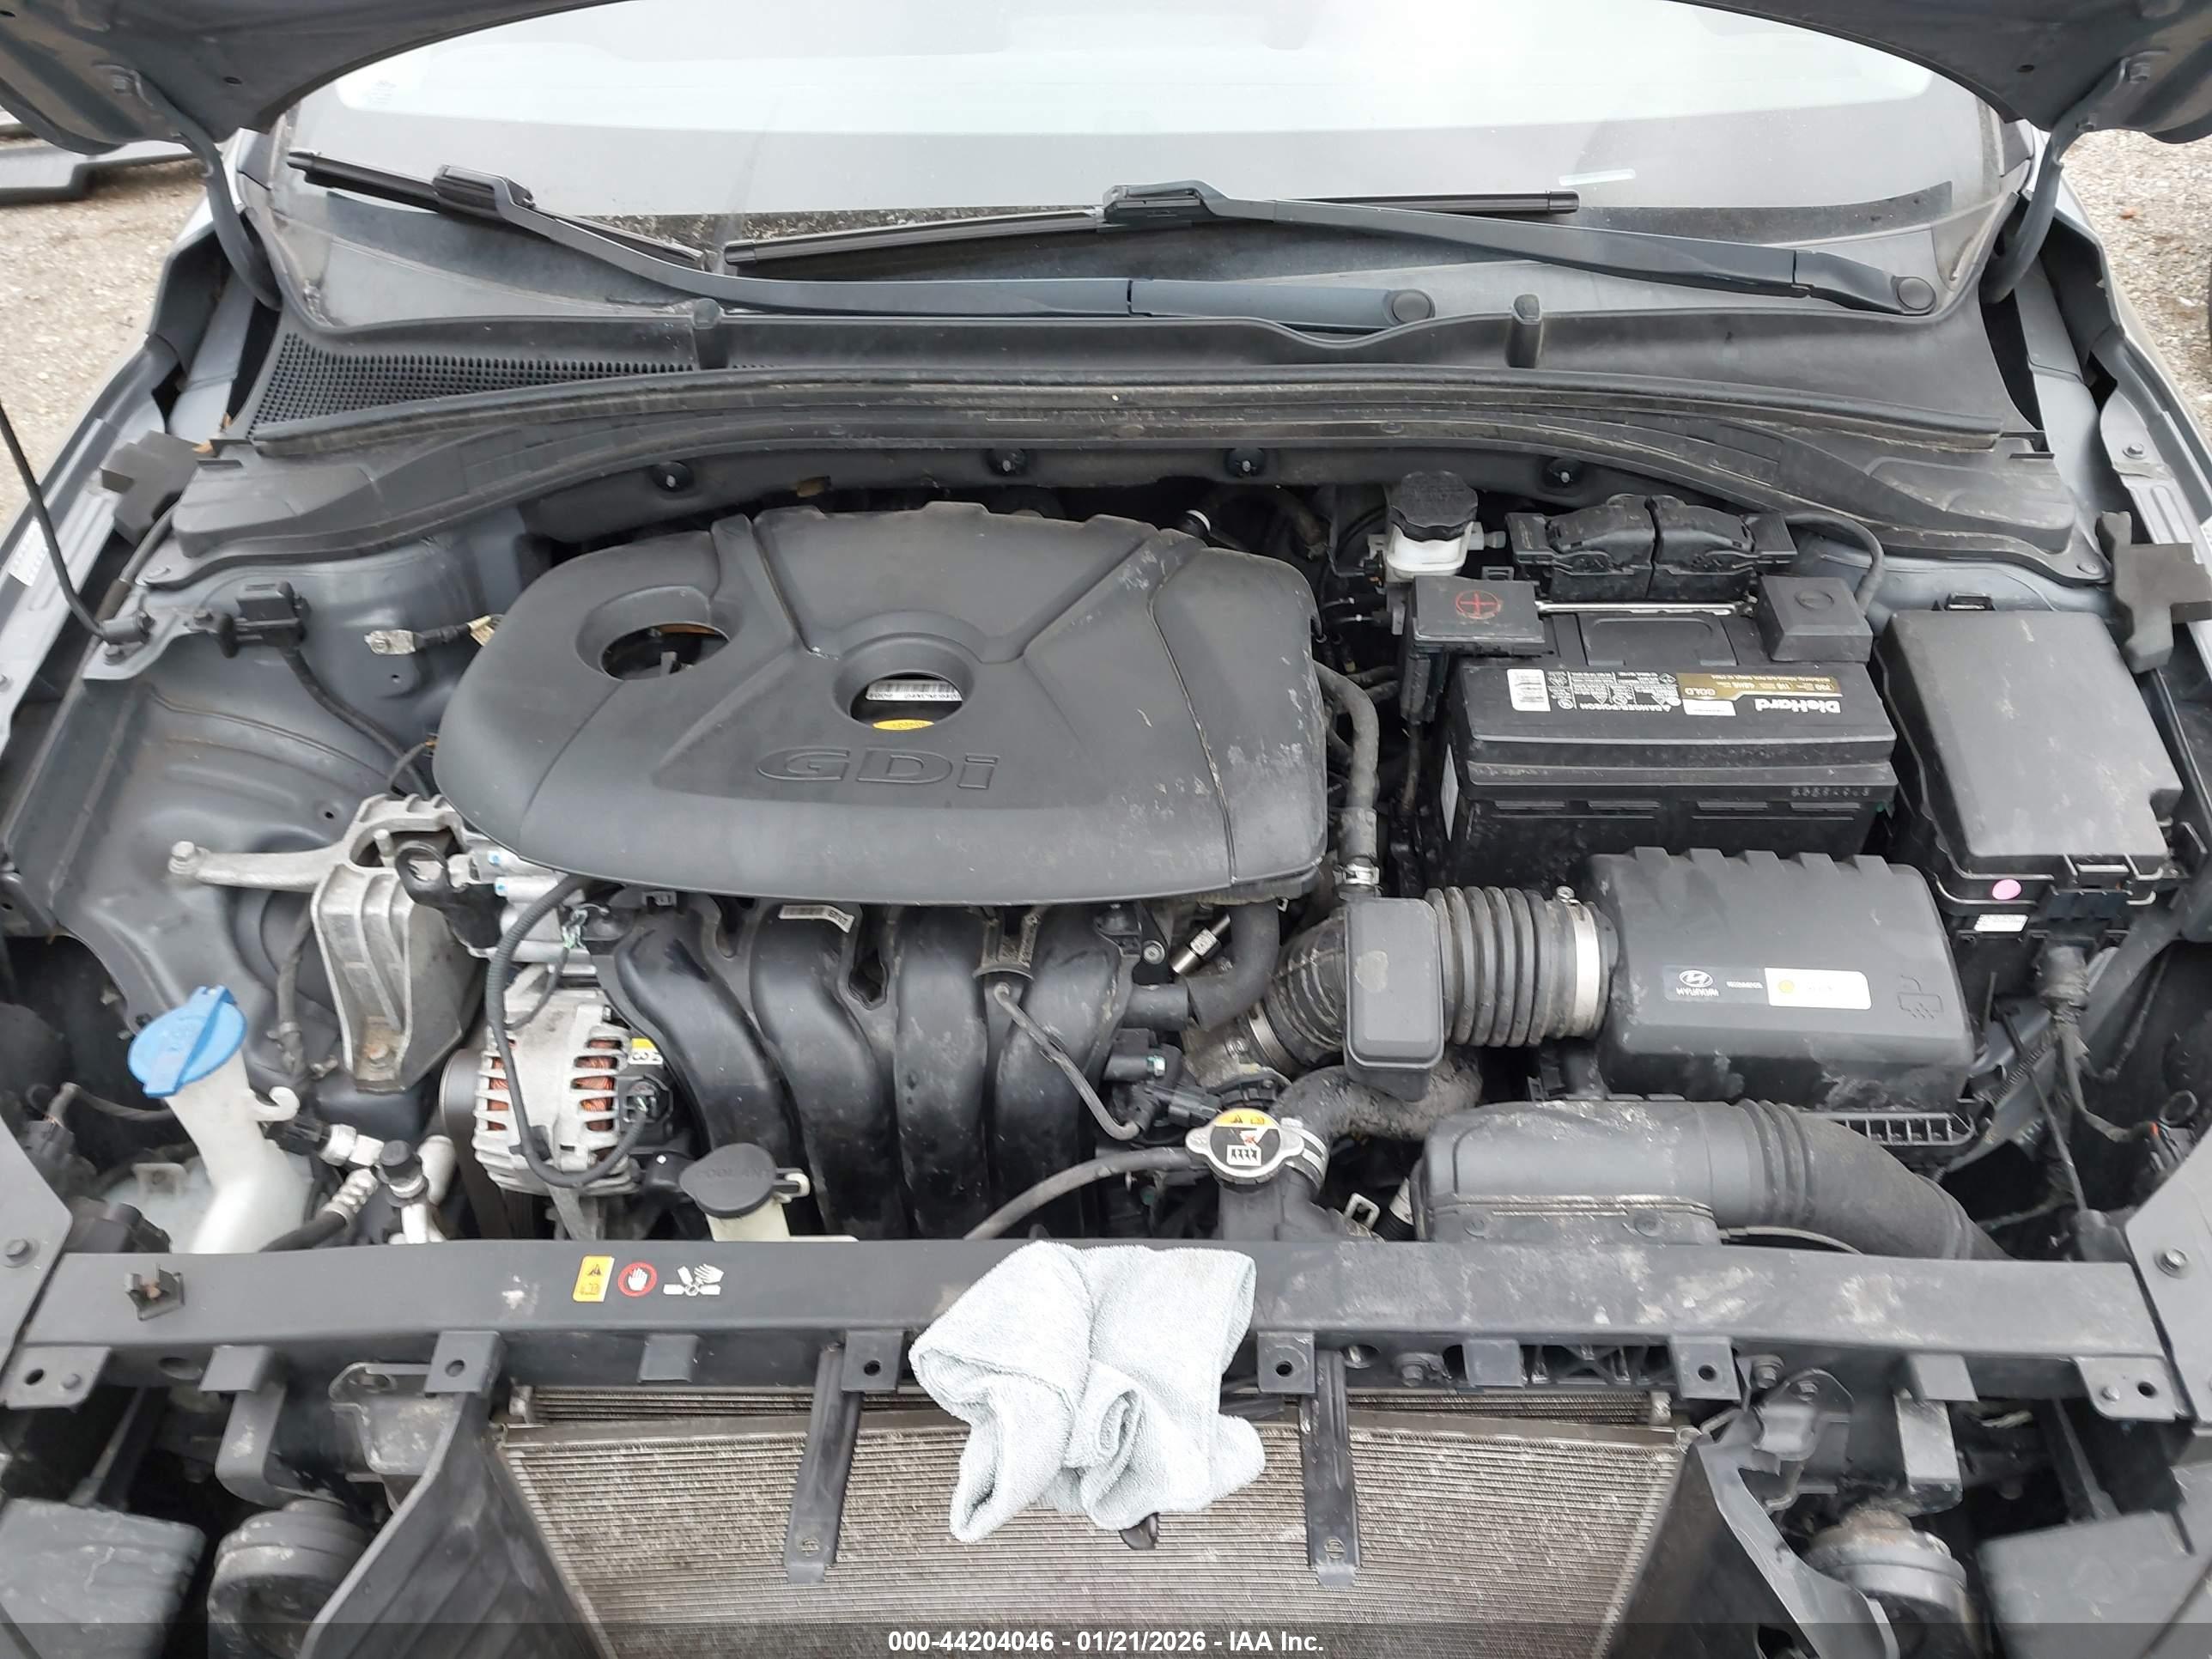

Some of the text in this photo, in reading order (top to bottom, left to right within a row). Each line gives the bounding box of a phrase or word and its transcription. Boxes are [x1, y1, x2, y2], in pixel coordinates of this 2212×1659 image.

[1685, 687, 1716, 696] GOLD
[1755, 697, 1841, 714] DieHard
[1675, 987, 1719, 997] HYUNDAI
